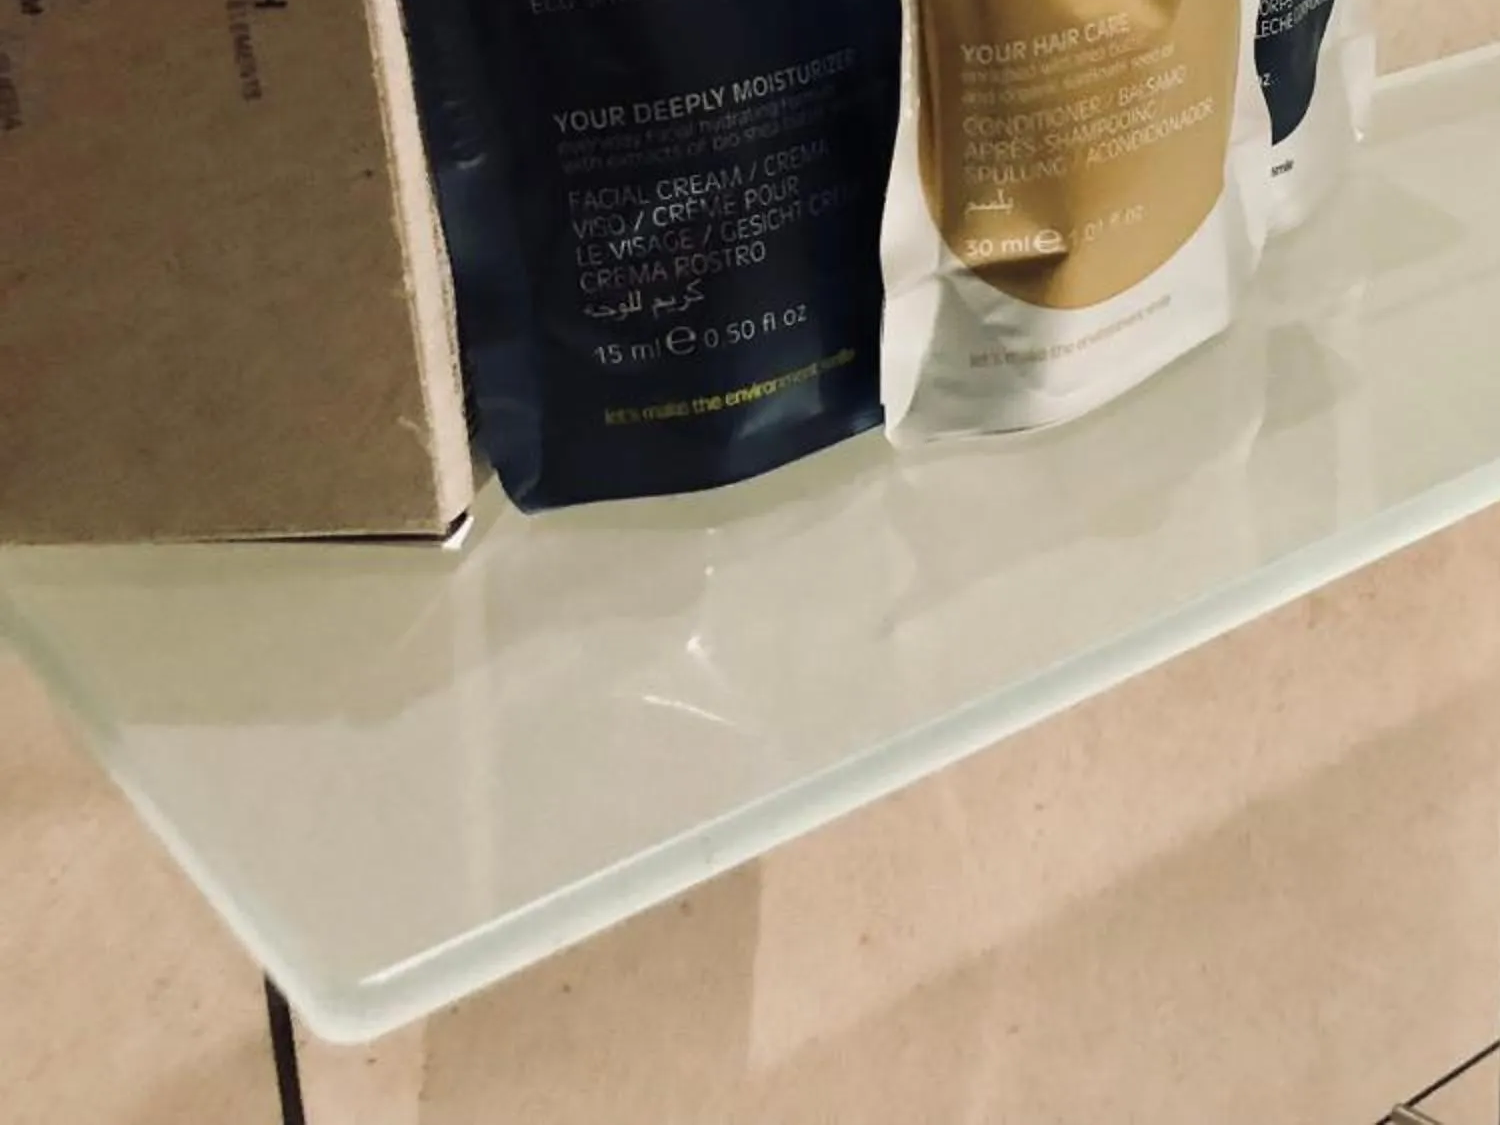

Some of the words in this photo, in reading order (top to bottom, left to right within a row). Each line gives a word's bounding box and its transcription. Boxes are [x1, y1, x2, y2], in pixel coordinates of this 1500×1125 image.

[960, 40, 1027, 65] YOUR
[1032, 27, 1080, 57] HAIR
[1084, 12, 1130, 43] CARE
[552, 106, 626, 134] YOUR
[633, 85, 727, 126] DEEPLY
[962, 94, 1104, 137] CONDITIONER
[568, 185, 650, 217] FACIAL
[656, 169, 743, 202] CREAM
[572, 212, 626, 241] VISO
[634, 210, 644, 232] /
[744, 175, 800, 211] POUR
[576, 243, 602, 268] LE
[609, 226, 695, 260] VISAGE
[720, 202, 802, 242] GESICHT
[966, 238, 994, 259] 30
[1001, 233, 1031, 253] ml
[579, 260, 668, 295] CREMA
[674, 240, 767, 278] ROSTRO
[594, 344, 623, 365] 15
[631, 338, 661, 361] ml
[783, 303, 808, 327] oz
[692, 394, 723, 415] the
